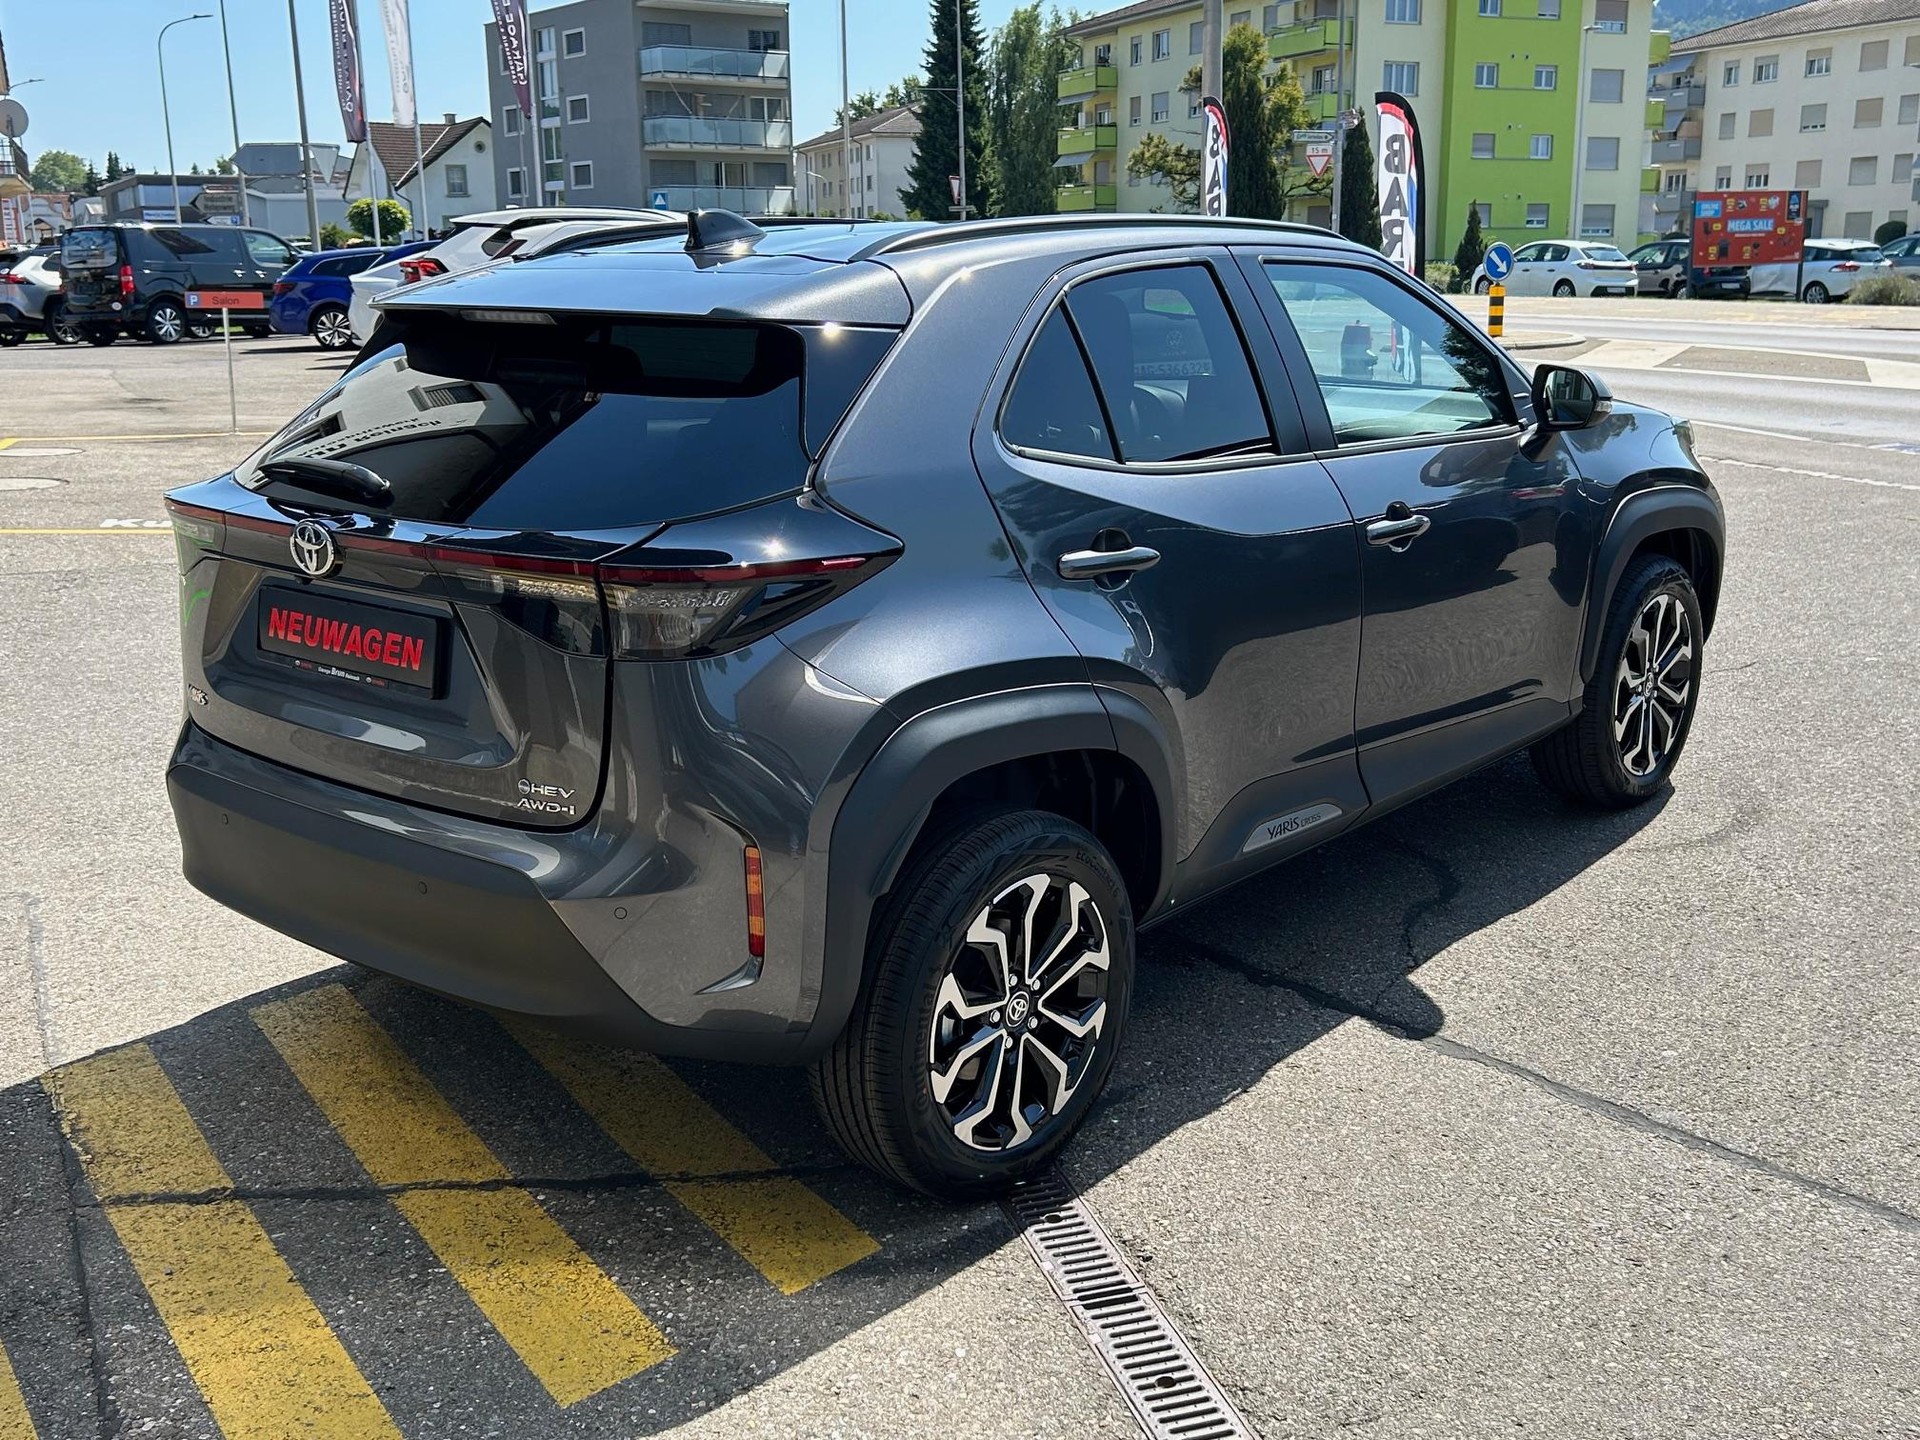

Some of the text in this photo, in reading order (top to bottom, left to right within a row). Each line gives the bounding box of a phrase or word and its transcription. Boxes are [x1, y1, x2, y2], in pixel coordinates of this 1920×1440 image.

[1727, 219, 1774, 232] MEGA SALE
[211, 296, 240, 305] Salon
[268, 608, 425, 671] NEUWAGEN
[331, 667, 346, 677] Brun
[531, 783, 575, 798] HEV
